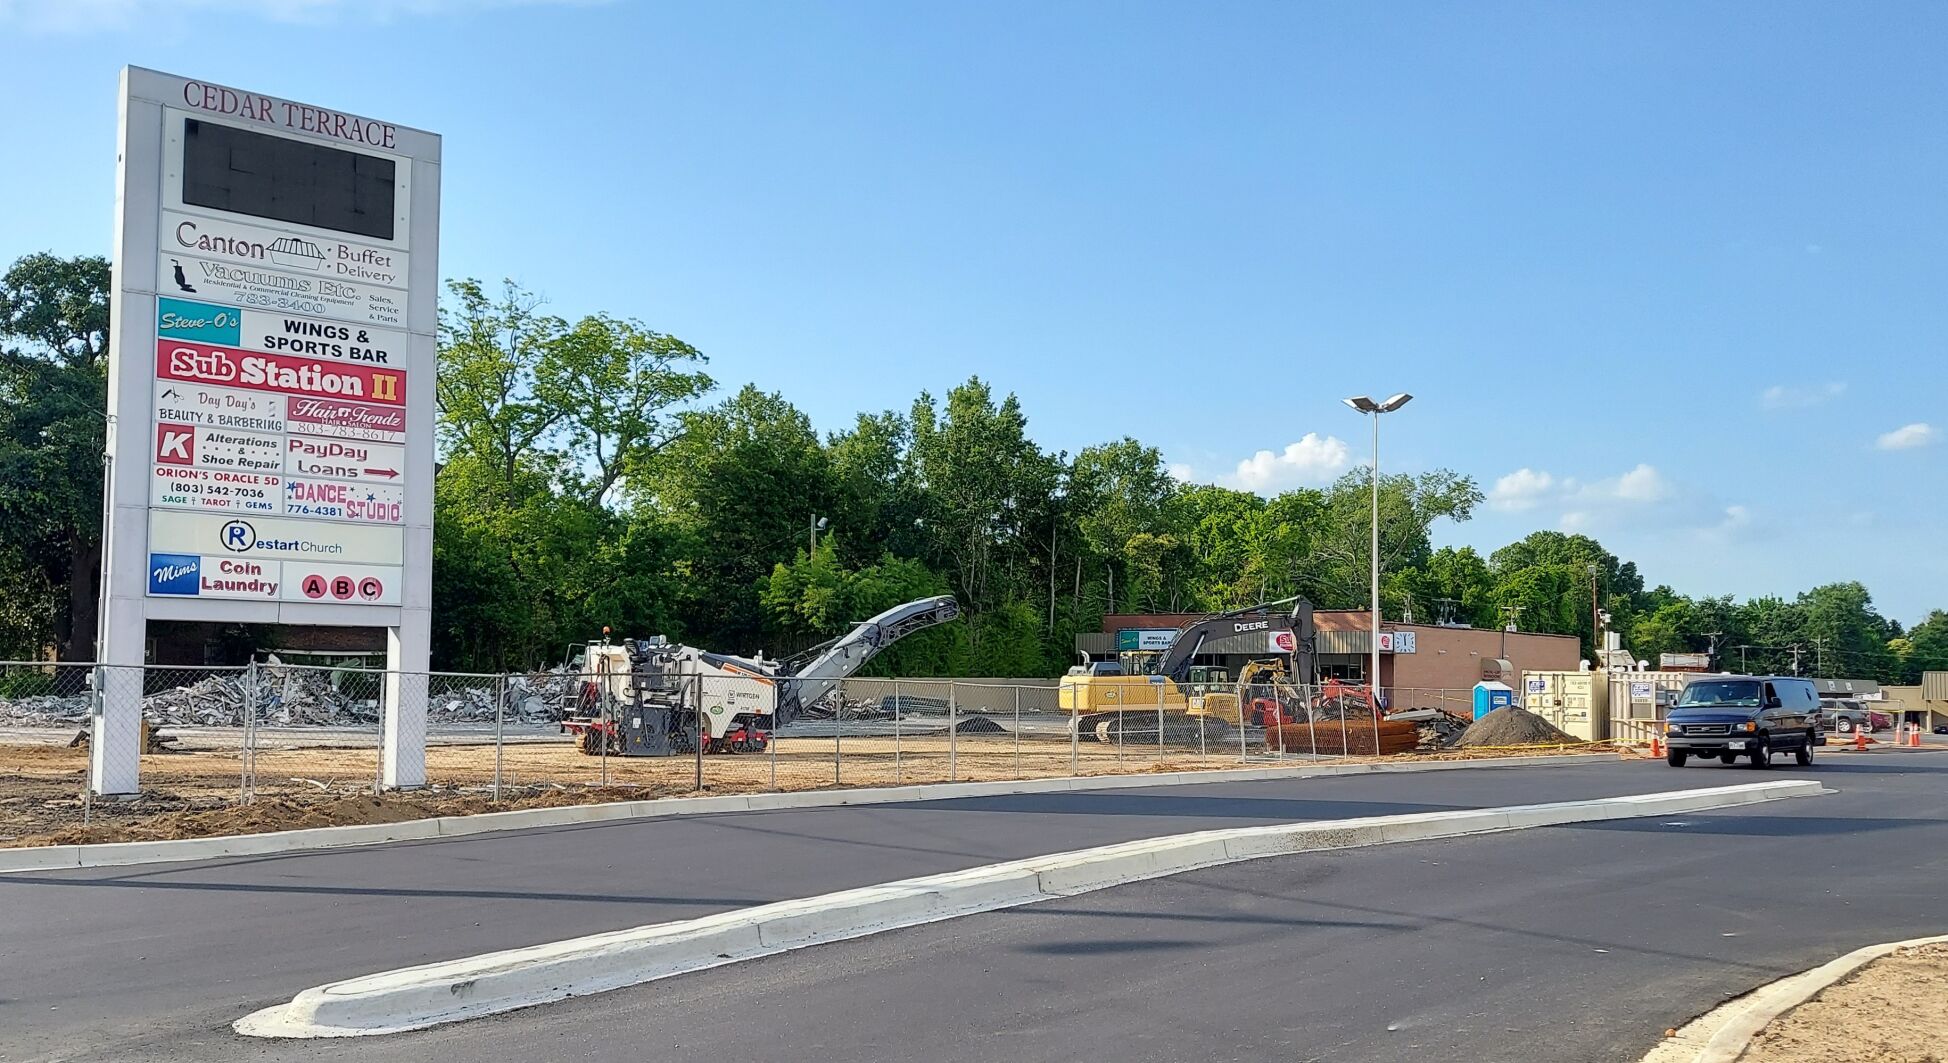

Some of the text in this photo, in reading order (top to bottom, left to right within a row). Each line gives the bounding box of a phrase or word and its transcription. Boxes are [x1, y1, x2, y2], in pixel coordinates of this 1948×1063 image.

[183, 81, 396, 149] CEDAR TERRACE
[175, 221, 265, 260] Canton
[337, 244, 391, 268] Buffet
[199, 260, 361, 300] Vacuums Etc.
[336, 262, 396, 285] Delivery
[203, 278, 242, 290] Residential
[249, 285, 289, 298] Commercial
[290, 290, 319, 302] Cleaning
[319, 295, 355, 307] Equipment
[233, 291, 326, 314] 783-3400
[369, 303, 399, 314] Service
[159, 312, 239, 330] Steve-O's
[377, 314, 398, 324] Parts
[284, 319, 370, 343] WINGS &
[264, 335, 388, 364] SPORTS BAR
[170, 348, 397, 401] Sub Station II
[198, 392, 256, 412] Day Day's
[159, 408, 282, 431] BEAUTY & BARBERING
[292, 399, 402, 427] Hair Trendz
[321, 417, 372, 429] HAIR SALON
[205, 433, 277, 449] Alterations
[297, 422, 396, 441] 803-783-8617
[159, 431, 193, 459] K
[238, 447, 245, 455] &
[289, 439, 368, 462] PayDay
[201, 454, 280, 470] Shoe Repair
[298, 459, 358, 478] Loans
[156, 467, 280, 486] ORION'S ORACLE 5D
[170, 481, 264, 498] (803) 542-7036
[295, 482, 347, 503] DANCE
[162, 495, 273, 510] SAGE TAROT GEMS
[287, 504, 342, 516] 776-4381
[346, 500, 400, 521] STUDIO
[300, 541, 342, 554] Church
[153, 561, 198, 583] Mims
[219, 560, 262, 576] Coin
[201, 576, 279, 596] Laundry
[1234, 620, 1269, 633] DEERE
[736, 692, 760, 700] WIRTGEN
